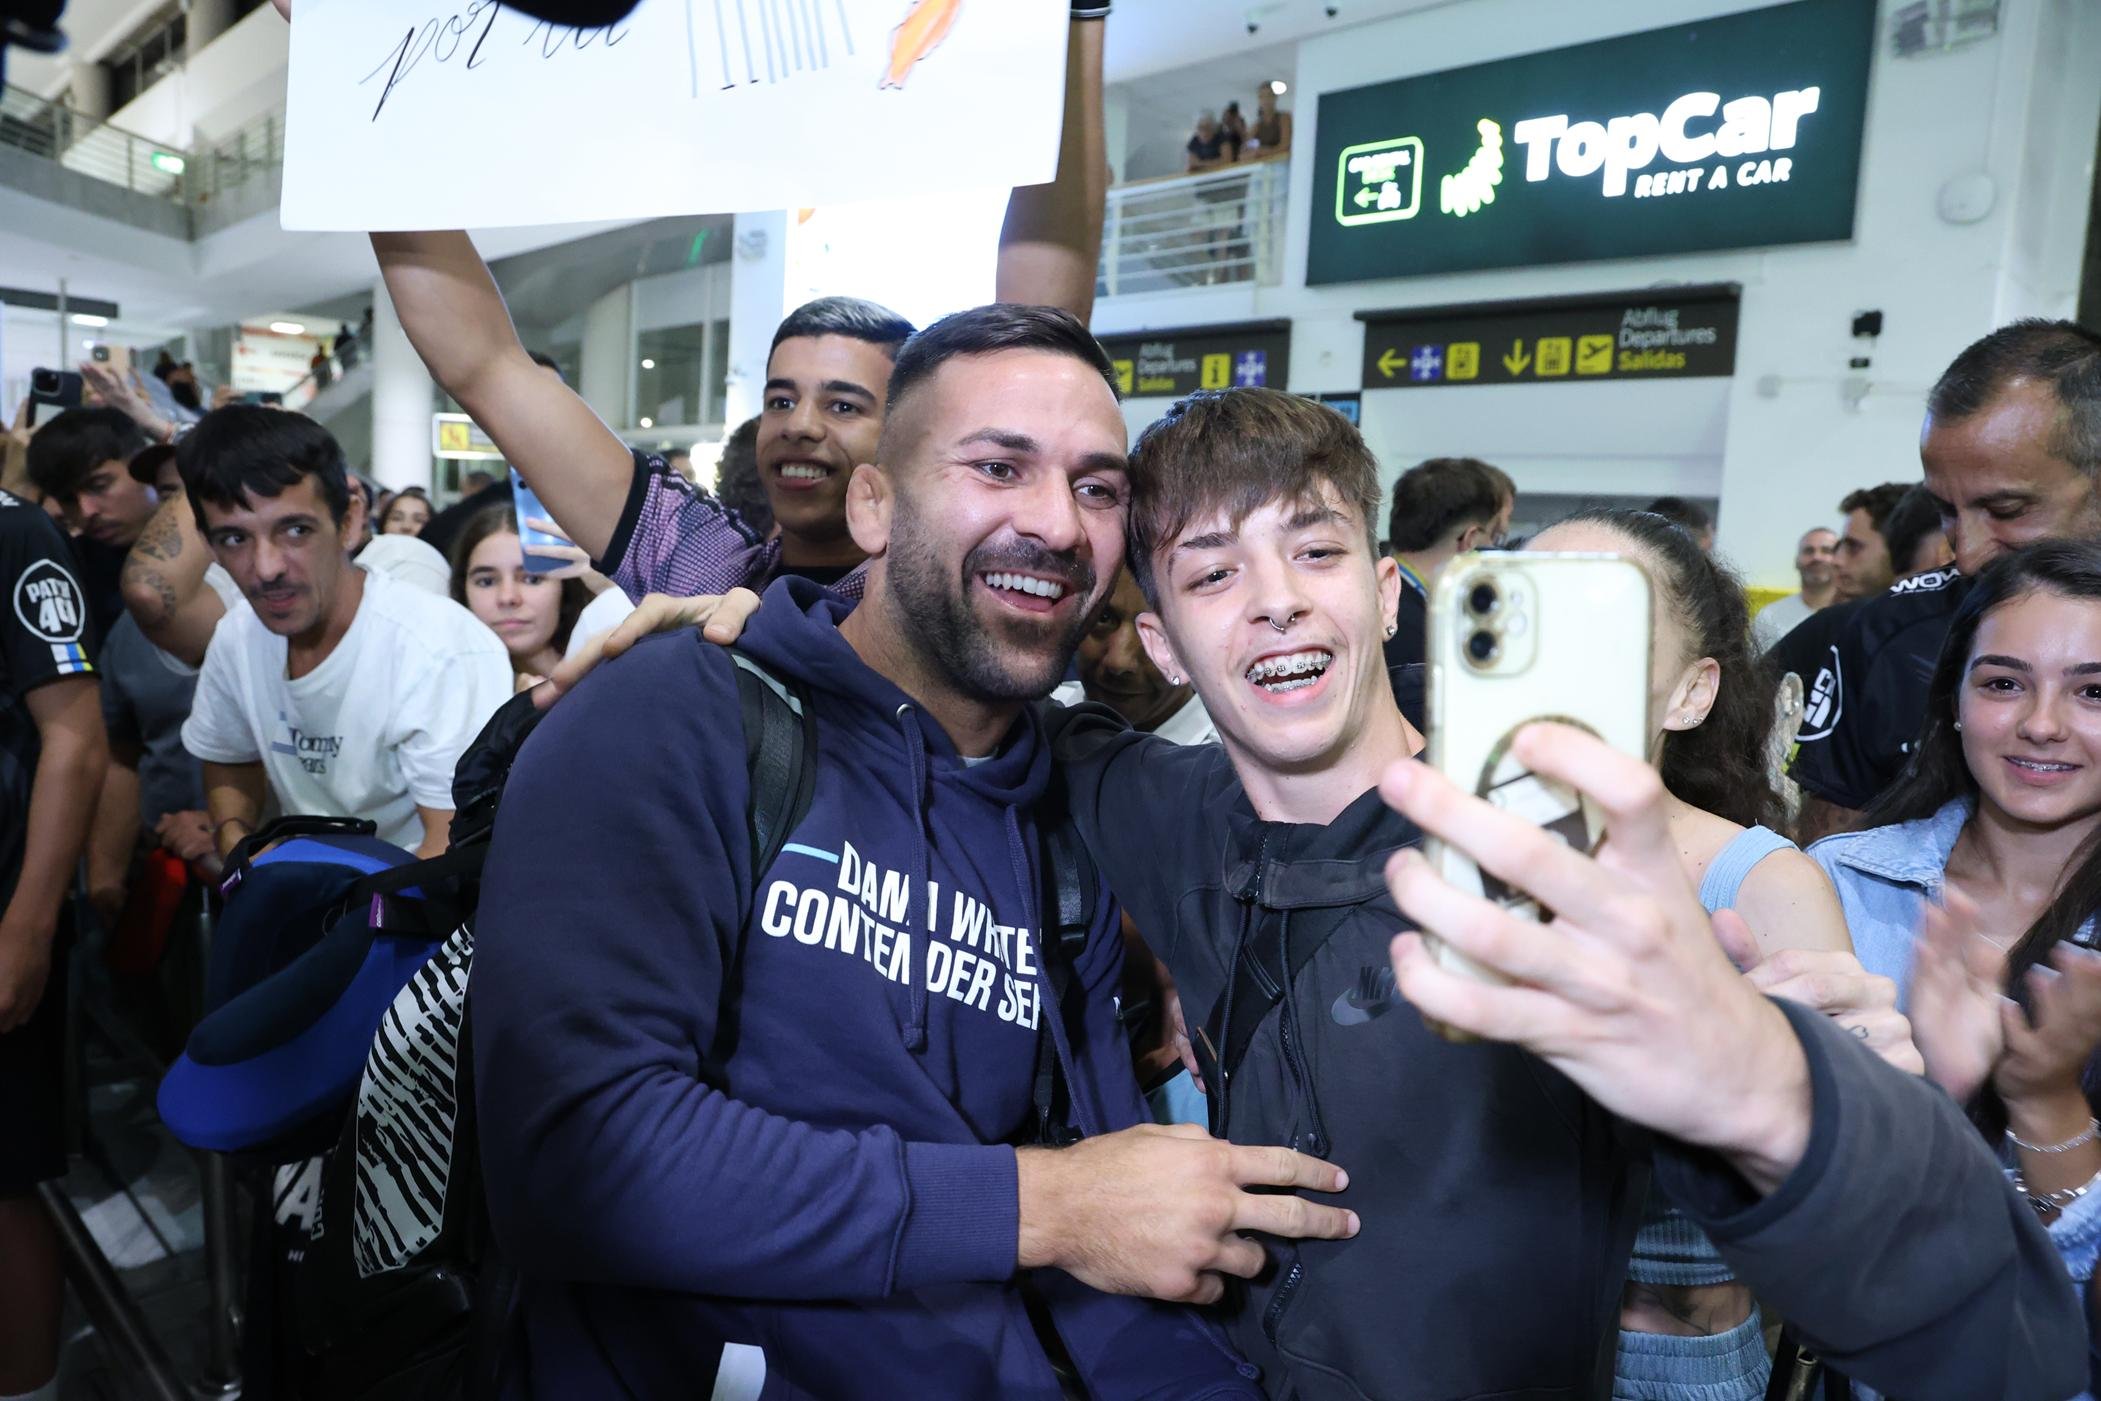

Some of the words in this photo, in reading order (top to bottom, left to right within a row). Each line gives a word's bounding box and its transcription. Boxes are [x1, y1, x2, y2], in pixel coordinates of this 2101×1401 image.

[1514, 86, 1821, 198] TopCar
[1634, 168, 1704, 199] RENT
[1707, 165, 1728, 190] A
[1736, 157, 1793, 187] CAR
[1619, 327, 1717, 351] Departures
[1618, 349, 1686, 371] Salidas
